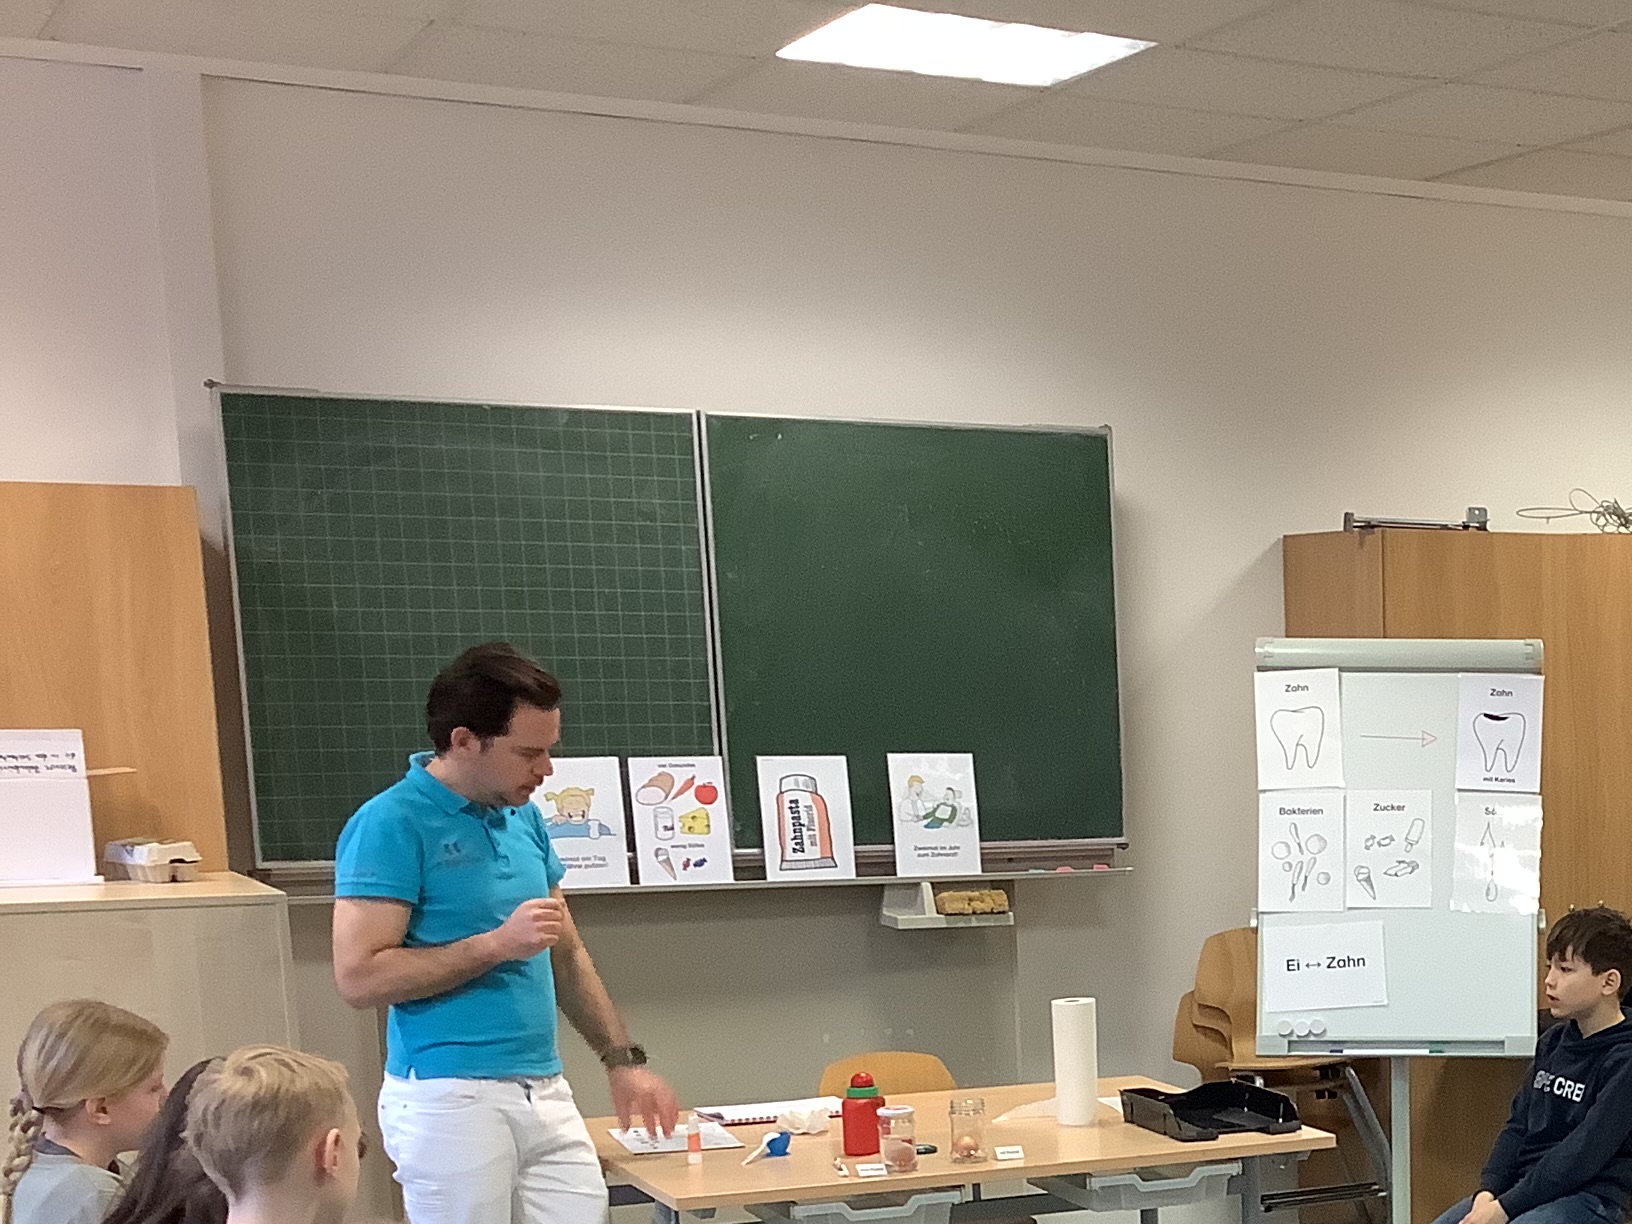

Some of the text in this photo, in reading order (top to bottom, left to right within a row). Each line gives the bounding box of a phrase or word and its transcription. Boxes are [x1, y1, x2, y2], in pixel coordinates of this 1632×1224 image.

[1285, 682, 1309, 693] Zahn
[1489, 688, 1513, 697] Zahn
[1278, 806, 1324, 816] Bakterien
[1373, 802, 1406, 813] Zucker
[788, 799, 805, 854] Zahnpasta
[1286, 955, 1366, 972] Ei Zahn
